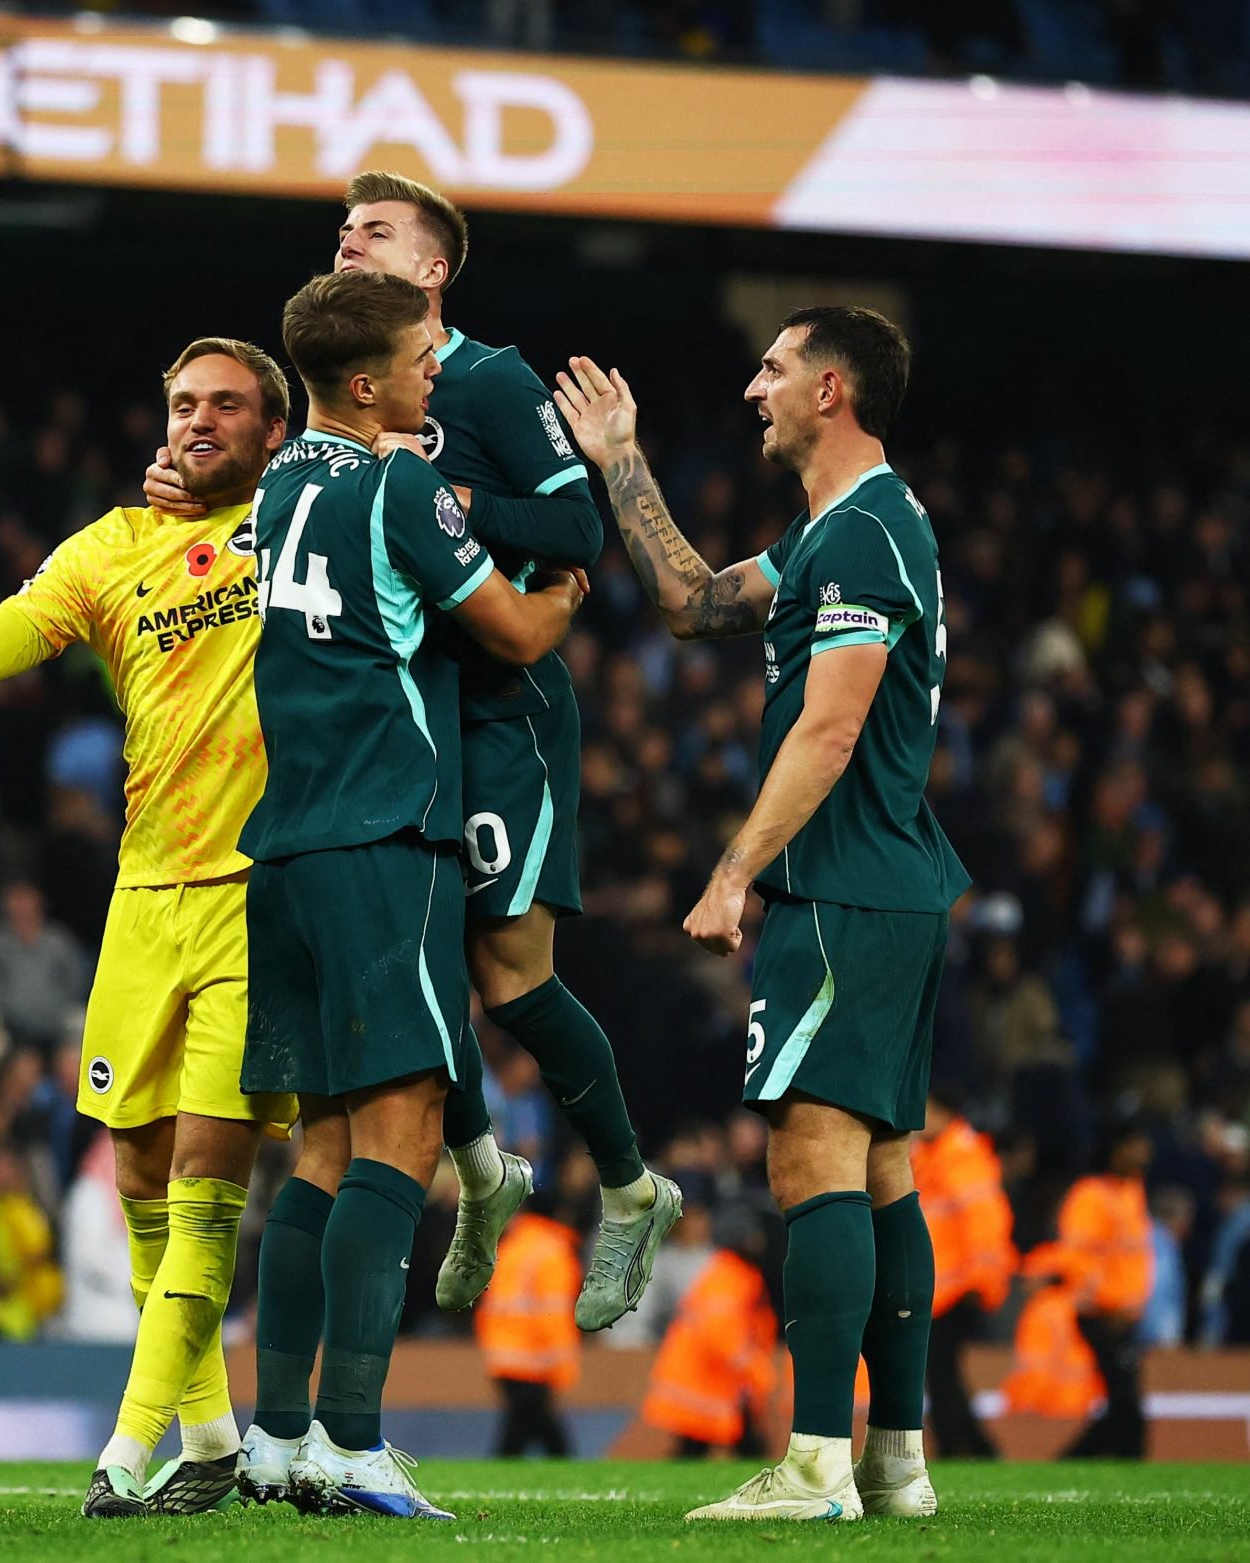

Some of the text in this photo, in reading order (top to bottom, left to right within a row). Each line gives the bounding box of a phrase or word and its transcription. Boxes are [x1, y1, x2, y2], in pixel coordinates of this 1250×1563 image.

[137, 576, 258, 636] AMERICAN
[464, 811, 511, 875] 0
[747, 999, 766, 1064] 5
